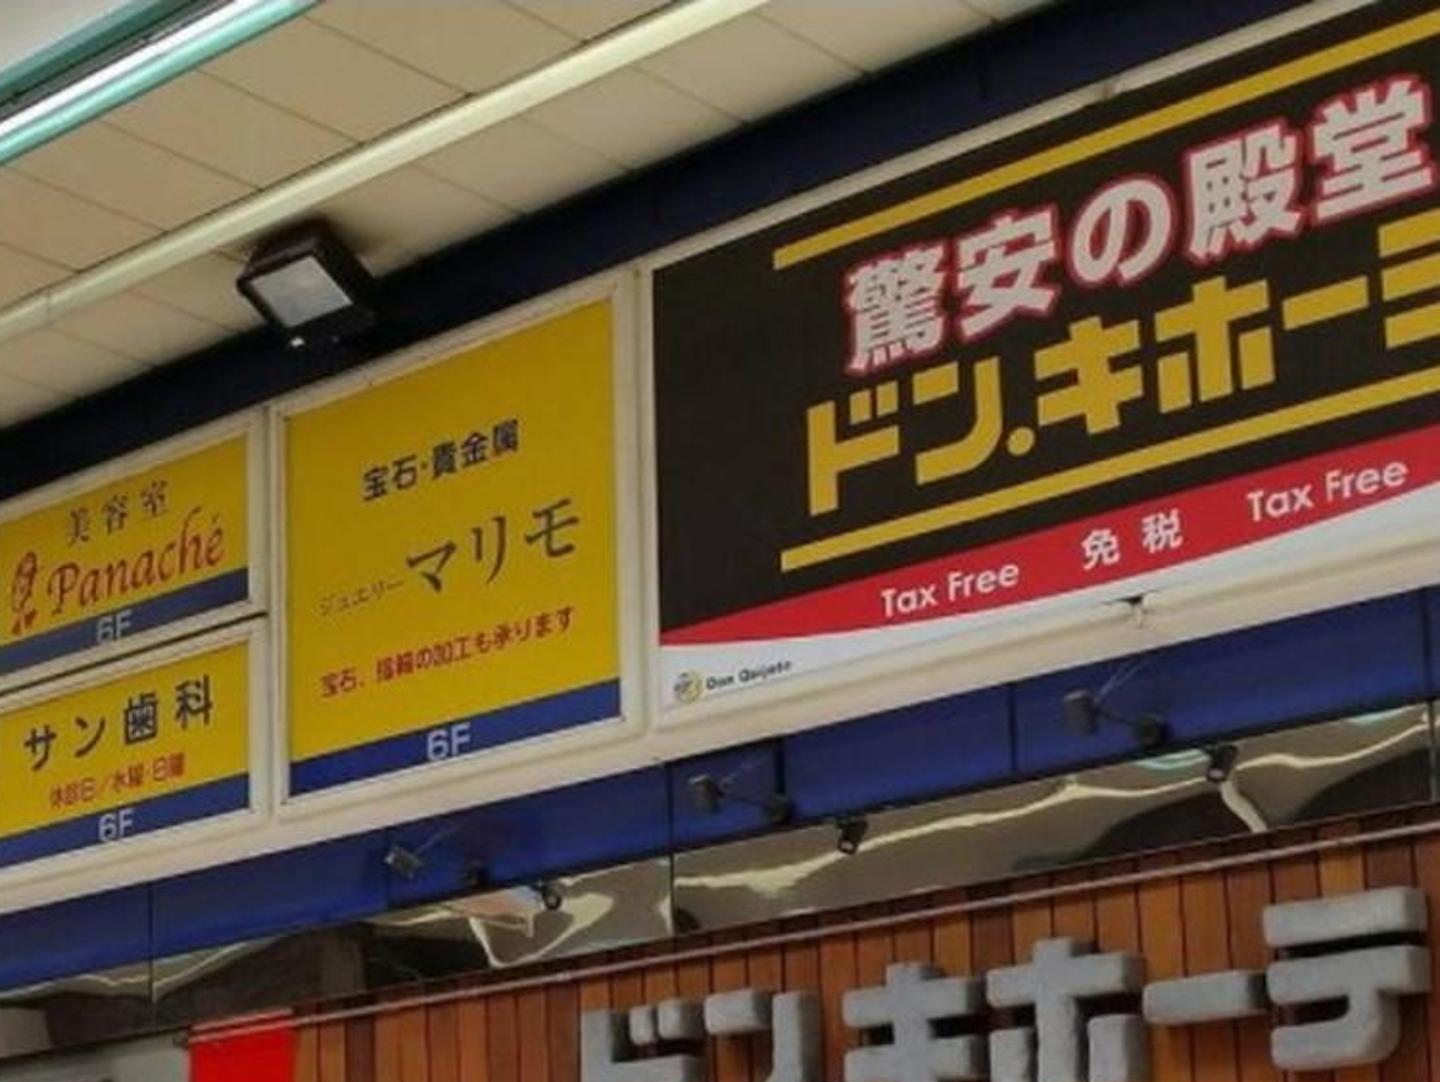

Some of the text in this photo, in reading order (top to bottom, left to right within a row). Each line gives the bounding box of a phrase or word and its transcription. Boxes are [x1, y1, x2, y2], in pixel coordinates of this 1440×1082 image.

[845, 76, 1436, 372] 驚安の殿堂
[67, 480, 170, 545] 美容室
[406, 499, 579, 593] マリモ
[882, 581, 937, 618] Tax
[948, 561, 1020, 602] Free
[1247, 485, 1314, 524] Tax
[1325, 459, 1408, 503] Free
[47, 507, 226, 615] Panaché
[96, 612, 134, 643] 6F
[24, 674, 214, 771] サン歯科
[426, 721, 472, 761] 6F
[97, 807, 135, 843] 6F
